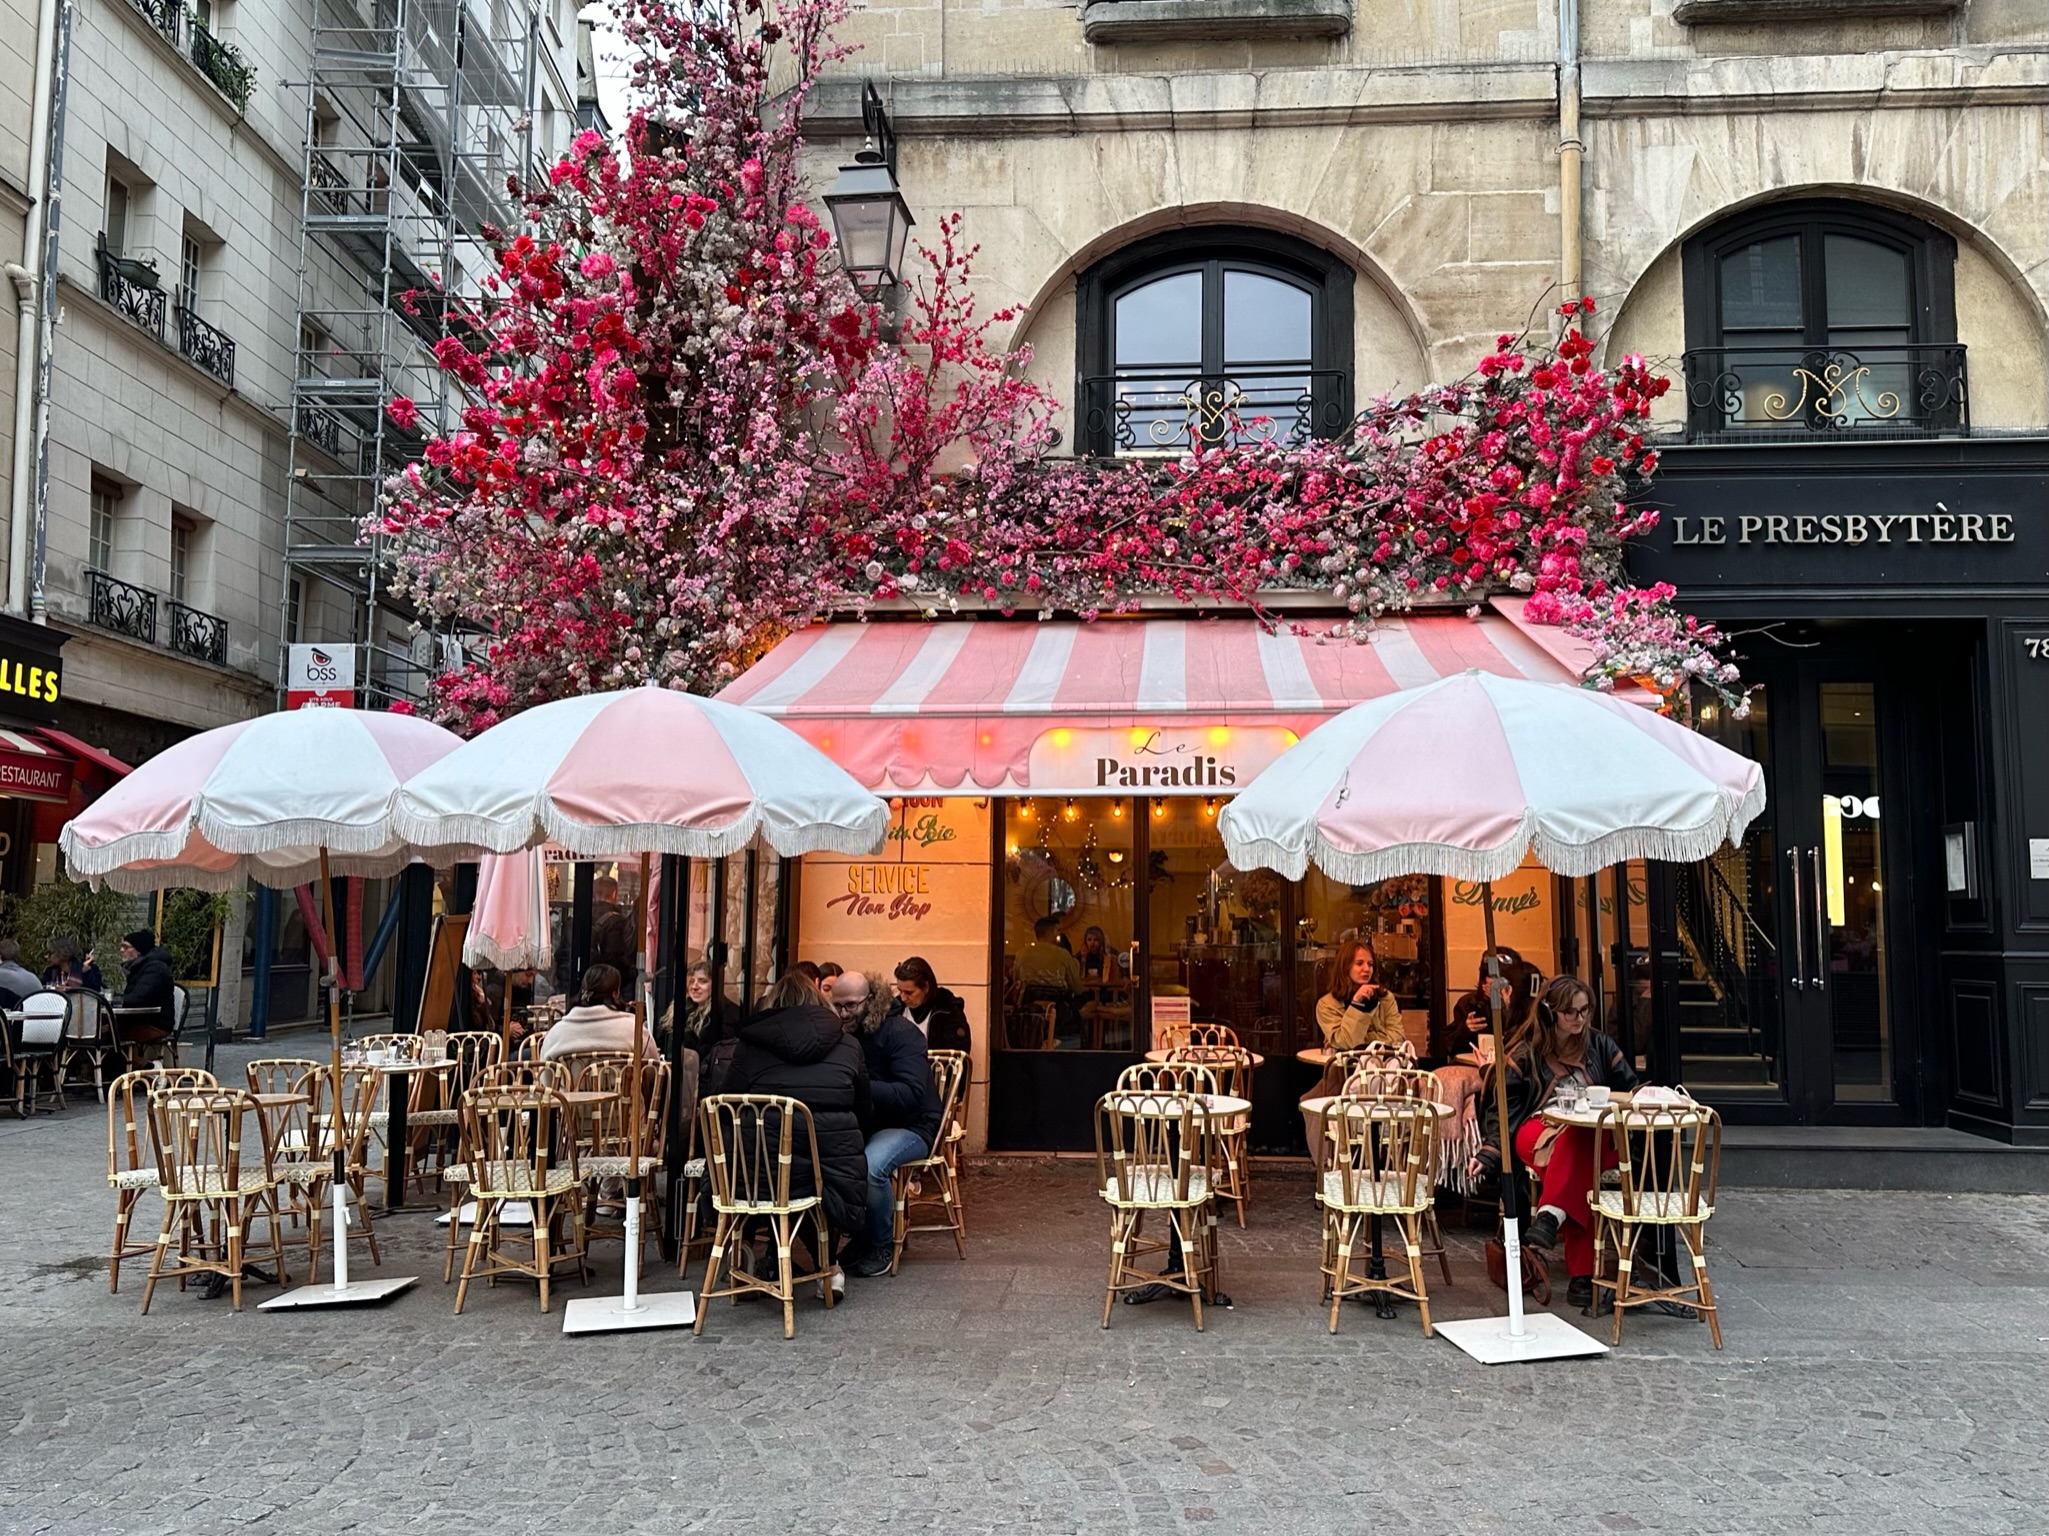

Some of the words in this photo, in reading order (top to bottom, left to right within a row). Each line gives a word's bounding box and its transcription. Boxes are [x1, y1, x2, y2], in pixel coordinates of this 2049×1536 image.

[1673, 516, 1726, 545] LE
[1738, 501, 2016, 544] PRESBYTÈRE
[2024, 638, 2049, 659] 78
[1134, 731, 1202, 755] Le
[0, 765, 61, 788] ESTAURANT
[1095, 756, 1236, 787] Paradis
[848, 865, 930, 894] SERVICE
[826, 893, 885, 916] Non
[888, 893, 931, 921] Stop
